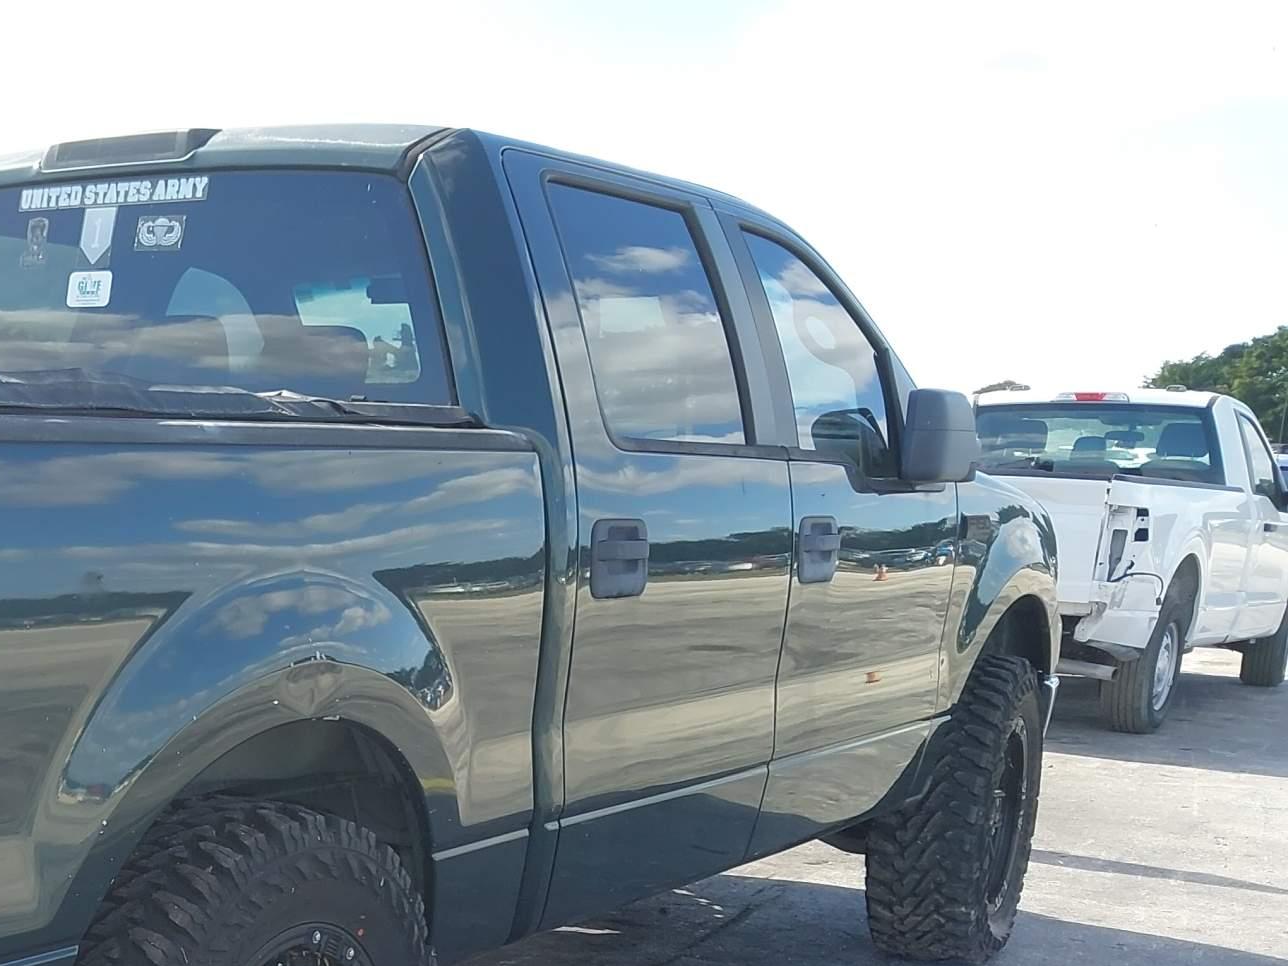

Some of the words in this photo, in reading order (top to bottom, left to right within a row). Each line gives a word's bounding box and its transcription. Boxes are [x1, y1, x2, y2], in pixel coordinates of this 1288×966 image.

[21, 186, 83, 209] UNITED
[83, 181, 152, 205] STATES
[152, 176, 208, 200] ARMY
